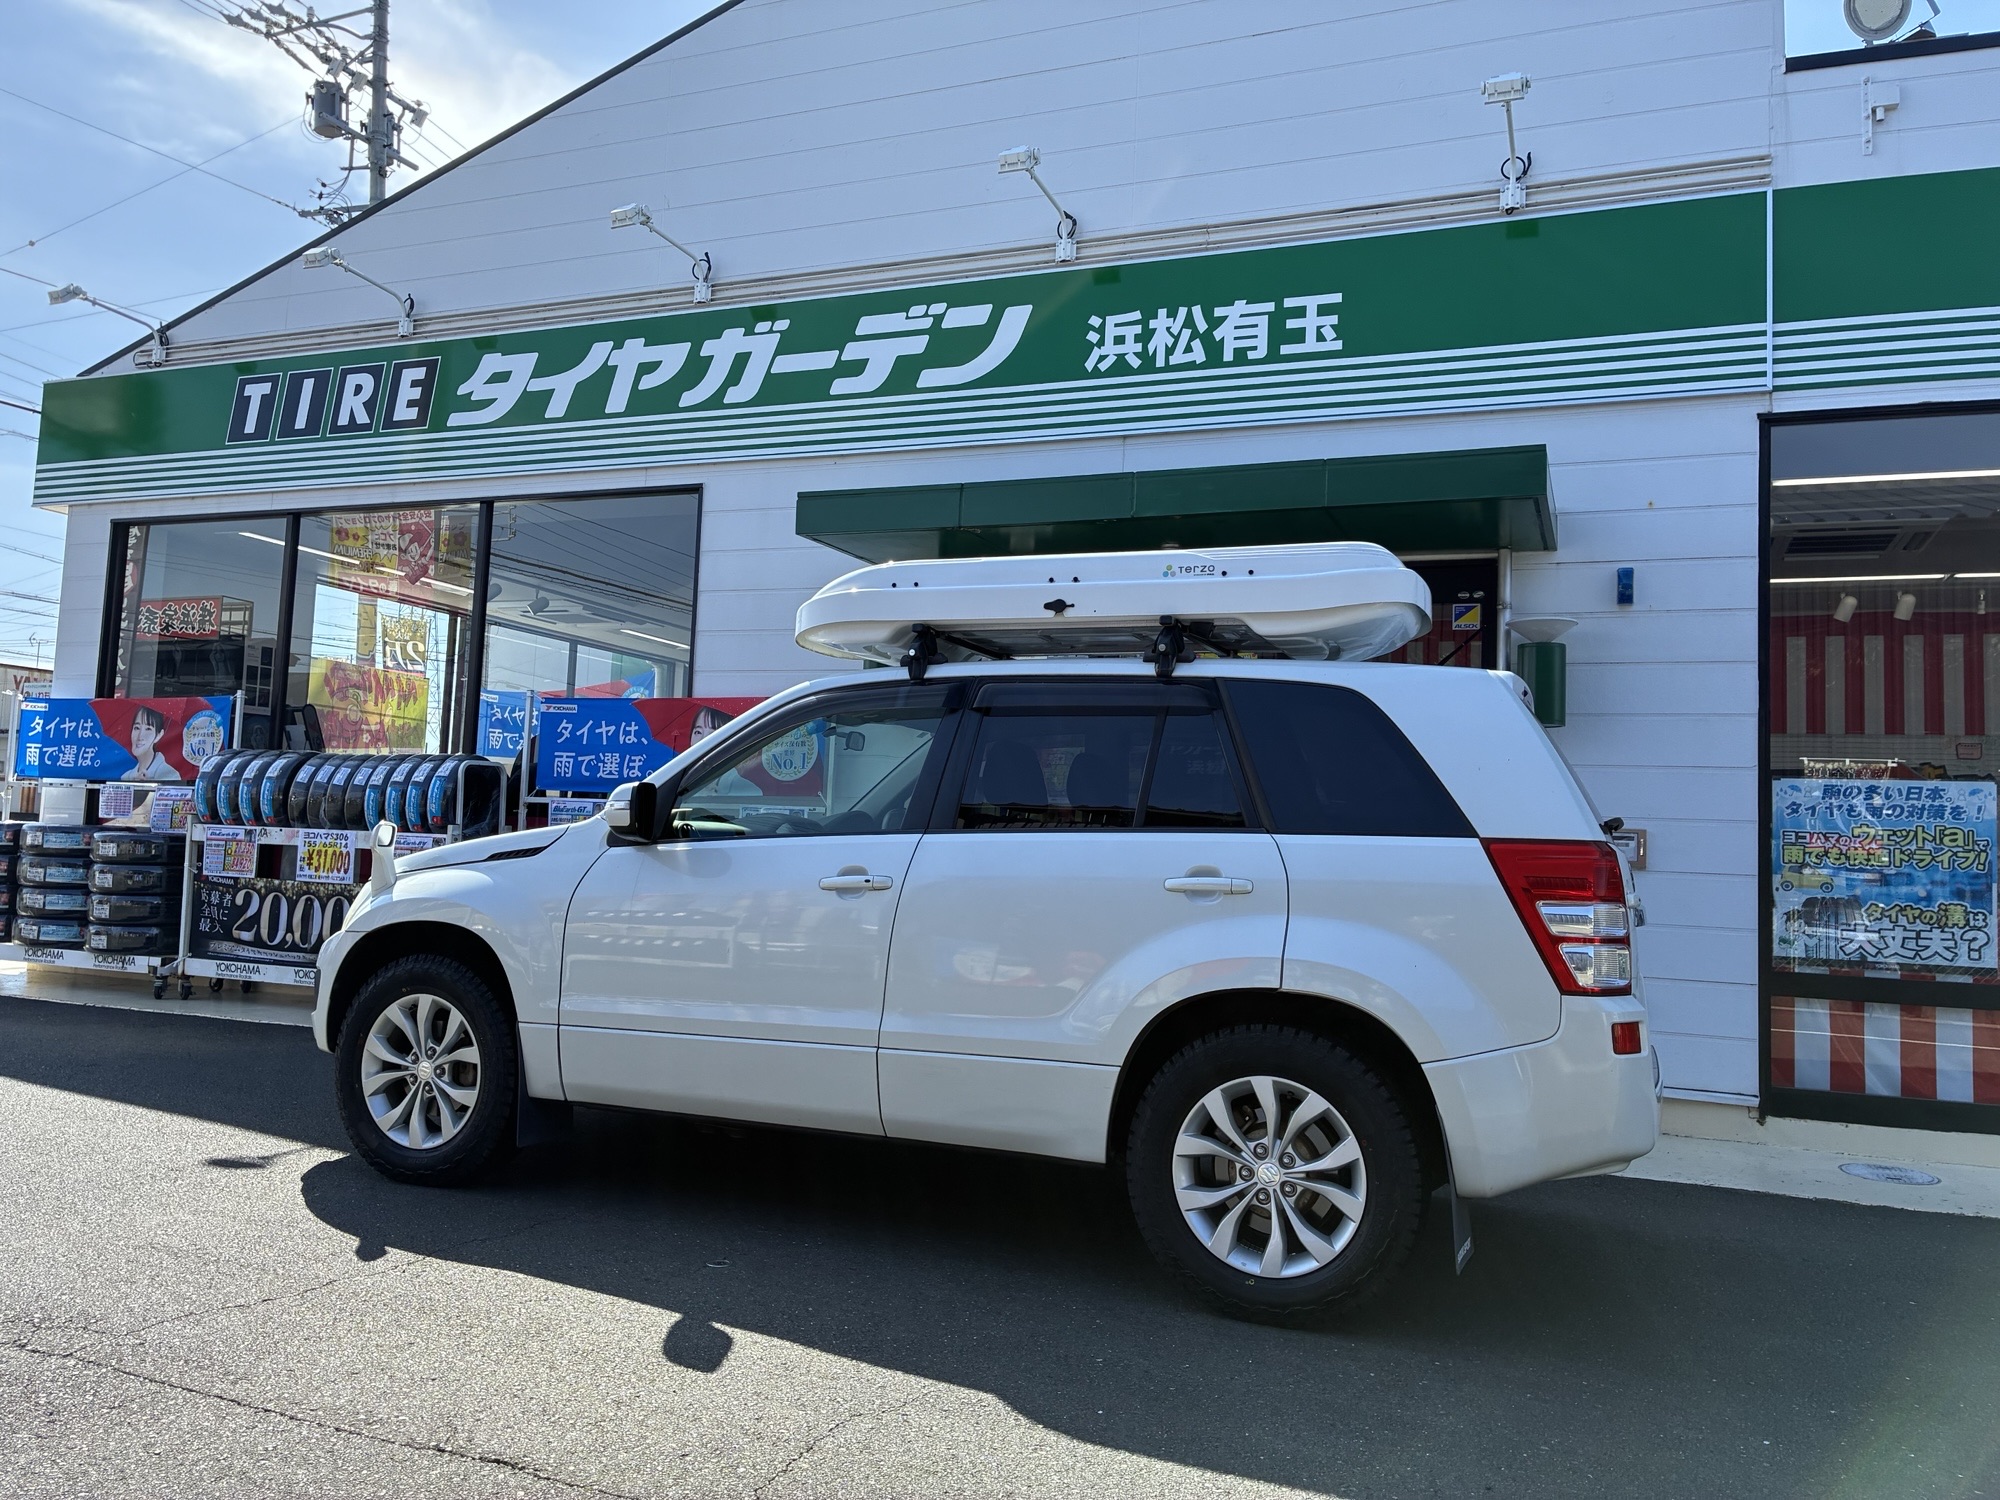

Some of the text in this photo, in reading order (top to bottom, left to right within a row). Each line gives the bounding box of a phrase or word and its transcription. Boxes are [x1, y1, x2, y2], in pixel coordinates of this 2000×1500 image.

[242, 292, 1343, 435] TIRE タイヤガーデン 浜松有玉
[28, 714, 101, 739] タイヤは、
[556, 719, 649, 746] タイヤは、
[25, 742, 101, 768] 雨で選ぼ。
[769, 752, 807, 771] No.1
[553, 751, 654, 779] 雨で選ぼ。
[1821, 783, 1953, 803] 雨の多い日本。
[303, 831, 349, 841] ヨコハマS306
[303, 840, 348, 850] 155/65R14
[208, 875, 235, 886] YOKOHAMA
[200, 903, 228, 921] 全員に
[1864, 901, 1988, 930] タイヤの溝は
[199, 918, 224, 934] 最大
[24, 948, 64, 960] YOKOHAMA
[93, 954, 135, 967] YOKOHAMA
[215, 962, 261, 975] YOKOHAMA
